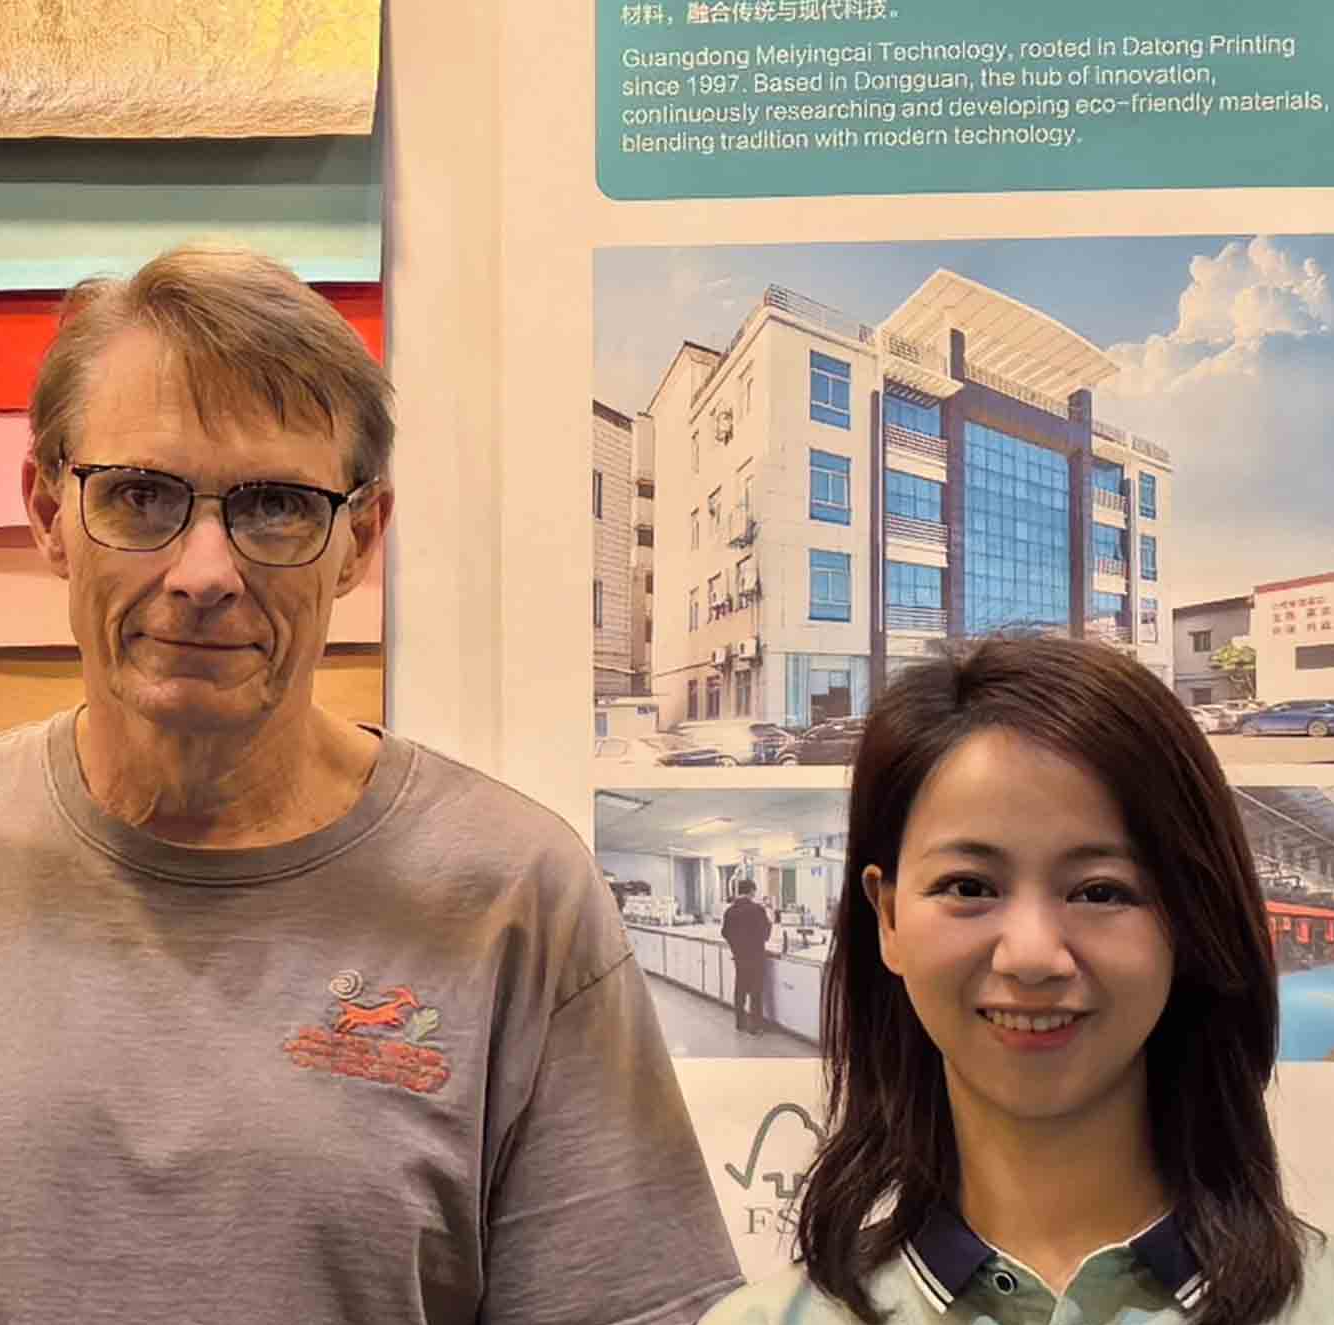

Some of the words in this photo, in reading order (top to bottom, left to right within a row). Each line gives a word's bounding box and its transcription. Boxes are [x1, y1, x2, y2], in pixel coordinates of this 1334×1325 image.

[622, 47, 749, 69] Guangdong
[756, 43, 872, 67] Meiyingcai
[876, 40, 1014, 63] Technology,
[1019, 38, 1091, 58] rooted
[1098, 37, 1116, 56] in
[1123, 36, 1203, 59] Datong
[1210, 34, 1296, 58] Printing
[622, 76, 680, 96] since
[686, 75, 747, 94] 1997.
[754, 72, 822, 93] Based
[829, 71, 847, 91] in
[855, 70, 975, 93] Dongguan,
[980, 68, 1016, 88] the
[1022, 66, 1062, 86] hub
[1067, 65, 1090, 85] of
[1095, 63, 1216, 88] innovation,
[622, 103, 760, 126] continuously
[765, 99, 896, 123] researching
[901, 98, 943, 118] and
[949, 96, 1070, 119] developing
[1075, 93, 1214, 116] eco-friendly
[1219, 90, 1330, 113] materials,
[622, 132, 716, 154] blending
[720, 129, 809, 151] tradition
[815, 128, 858, 148] with
[864, 126, 948, 146] modern
[954, 123, 1083, 146] technology.
